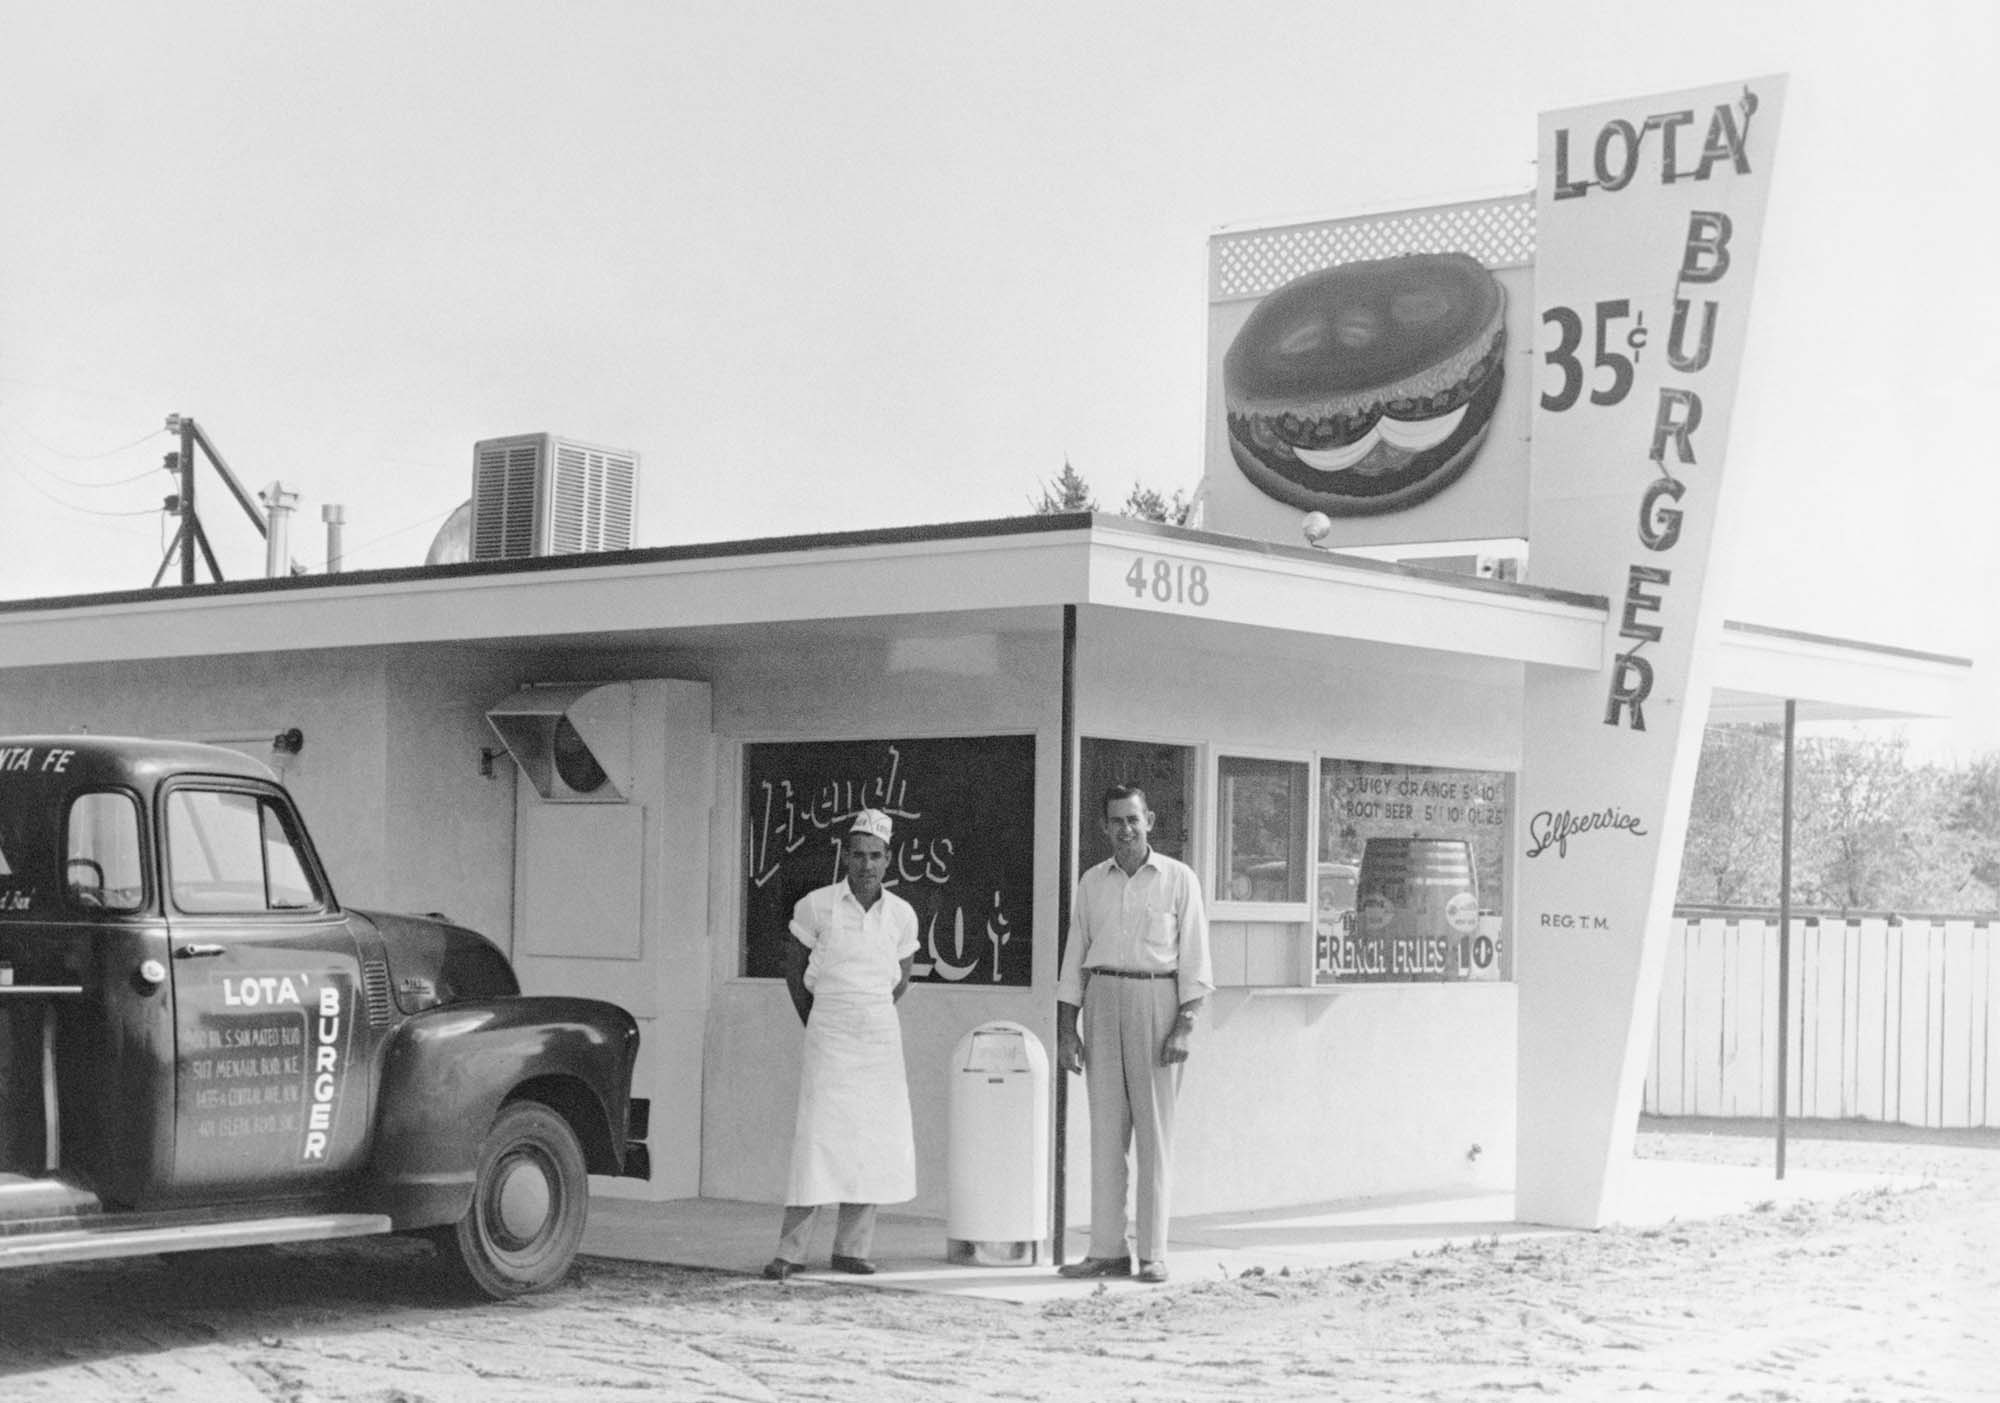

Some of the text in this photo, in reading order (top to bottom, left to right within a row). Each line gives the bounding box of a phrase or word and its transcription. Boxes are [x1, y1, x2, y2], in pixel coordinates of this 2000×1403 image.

[1540, 299, 1648, 412] 35¢
[1603, 210, 1733, 732] BURGER
[1125, 556, 1209, 607] 4818
[41, 749, 76, 773] FE
[1347, 801, 1380, 818] ROOT
[1385, 803, 1413, 820] BEER
[1399, 780, 1457, 800] ORANGE
[1526, 807, 1648, 859] Selfservice
[1316, 935, 1386, 975] FRENCH
[1392, 936, 1448, 975] FRIES
[304, 987, 340, 1159] BURGER
